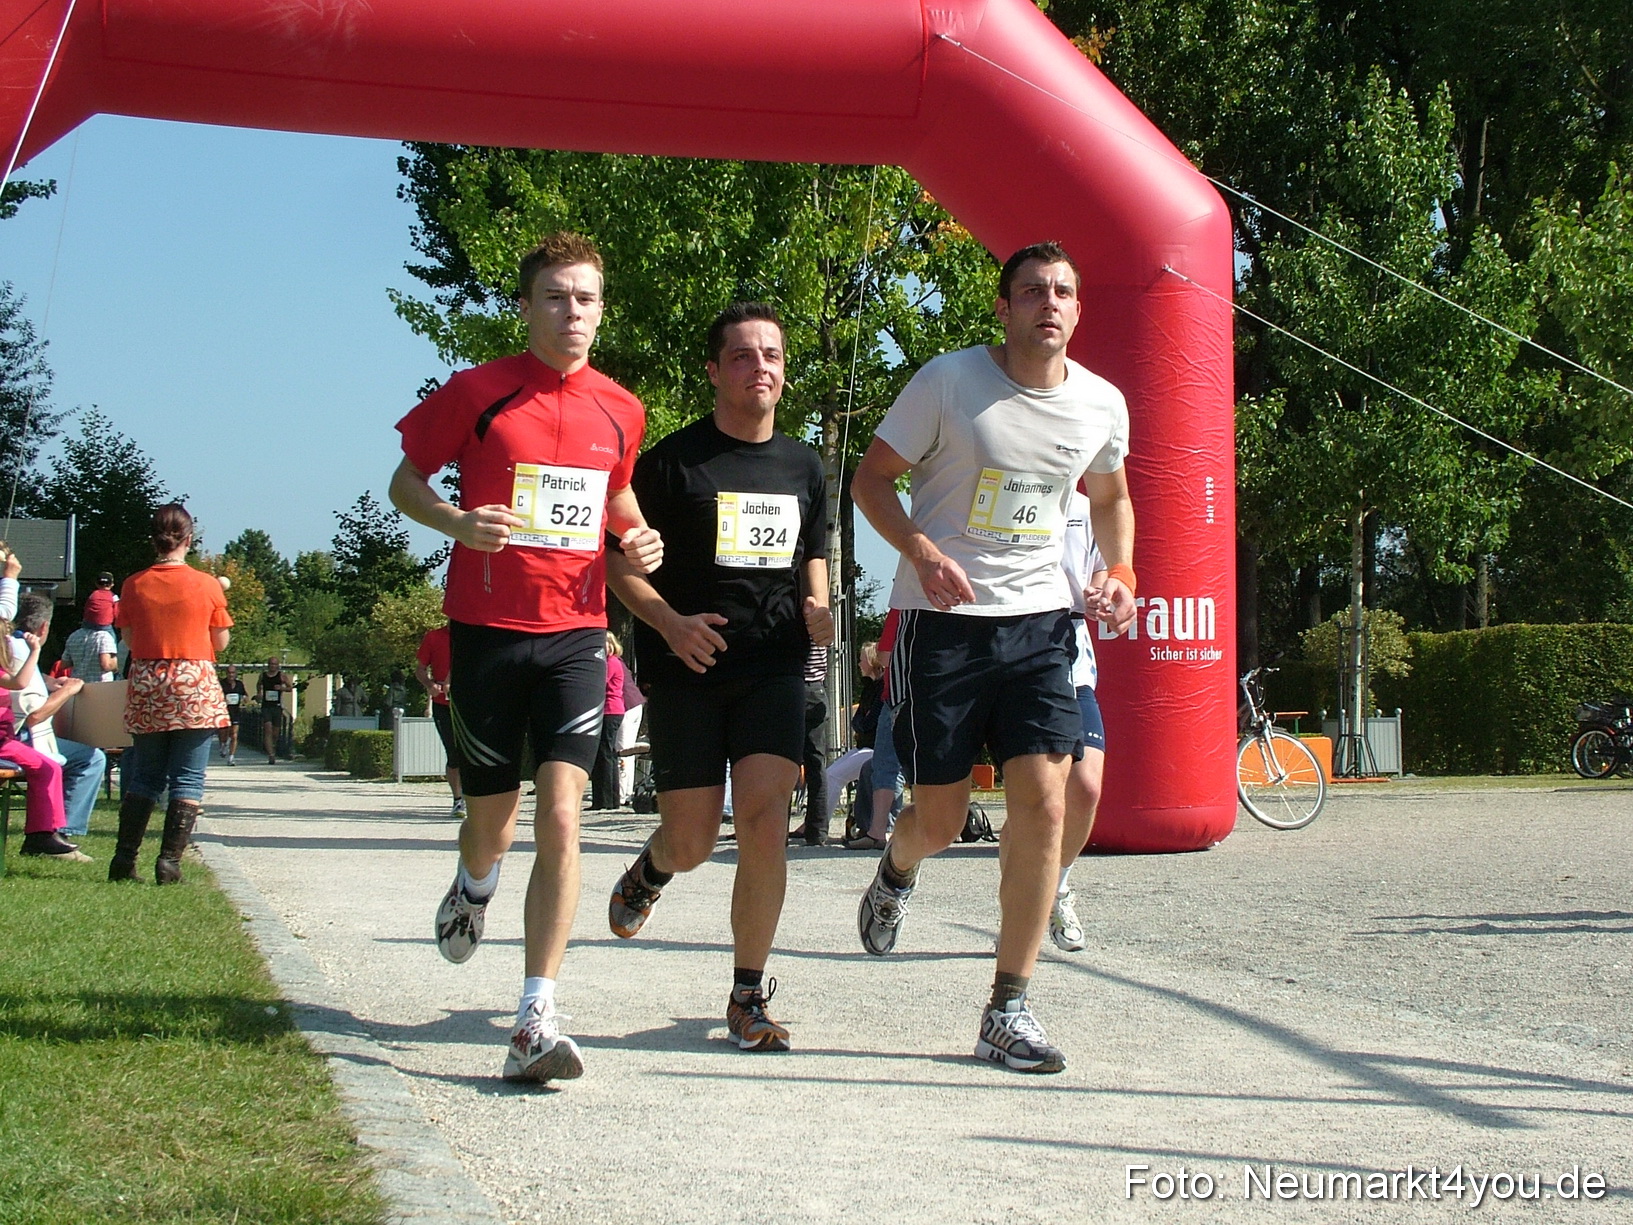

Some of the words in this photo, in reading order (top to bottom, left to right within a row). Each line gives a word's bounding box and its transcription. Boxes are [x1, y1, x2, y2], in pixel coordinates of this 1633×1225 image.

[541, 473, 587, 492] Patrick
[1003, 477, 1054, 494] Johannes
[1205, 476, 1215, 501] 1929
[517, 495, 524, 507] C
[741, 500, 781, 516] Jochen
[550, 503, 592, 527] 522
[1012, 505, 1038, 524] 46
[749, 526, 787, 547] 324
[1020, 533, 1051, 541] PFLEIDERER
[1150, 645, 1183, 661] Sicher
[1186, 646, 1198, 661] ist
[1200, 645, 1223, 661] sicher
